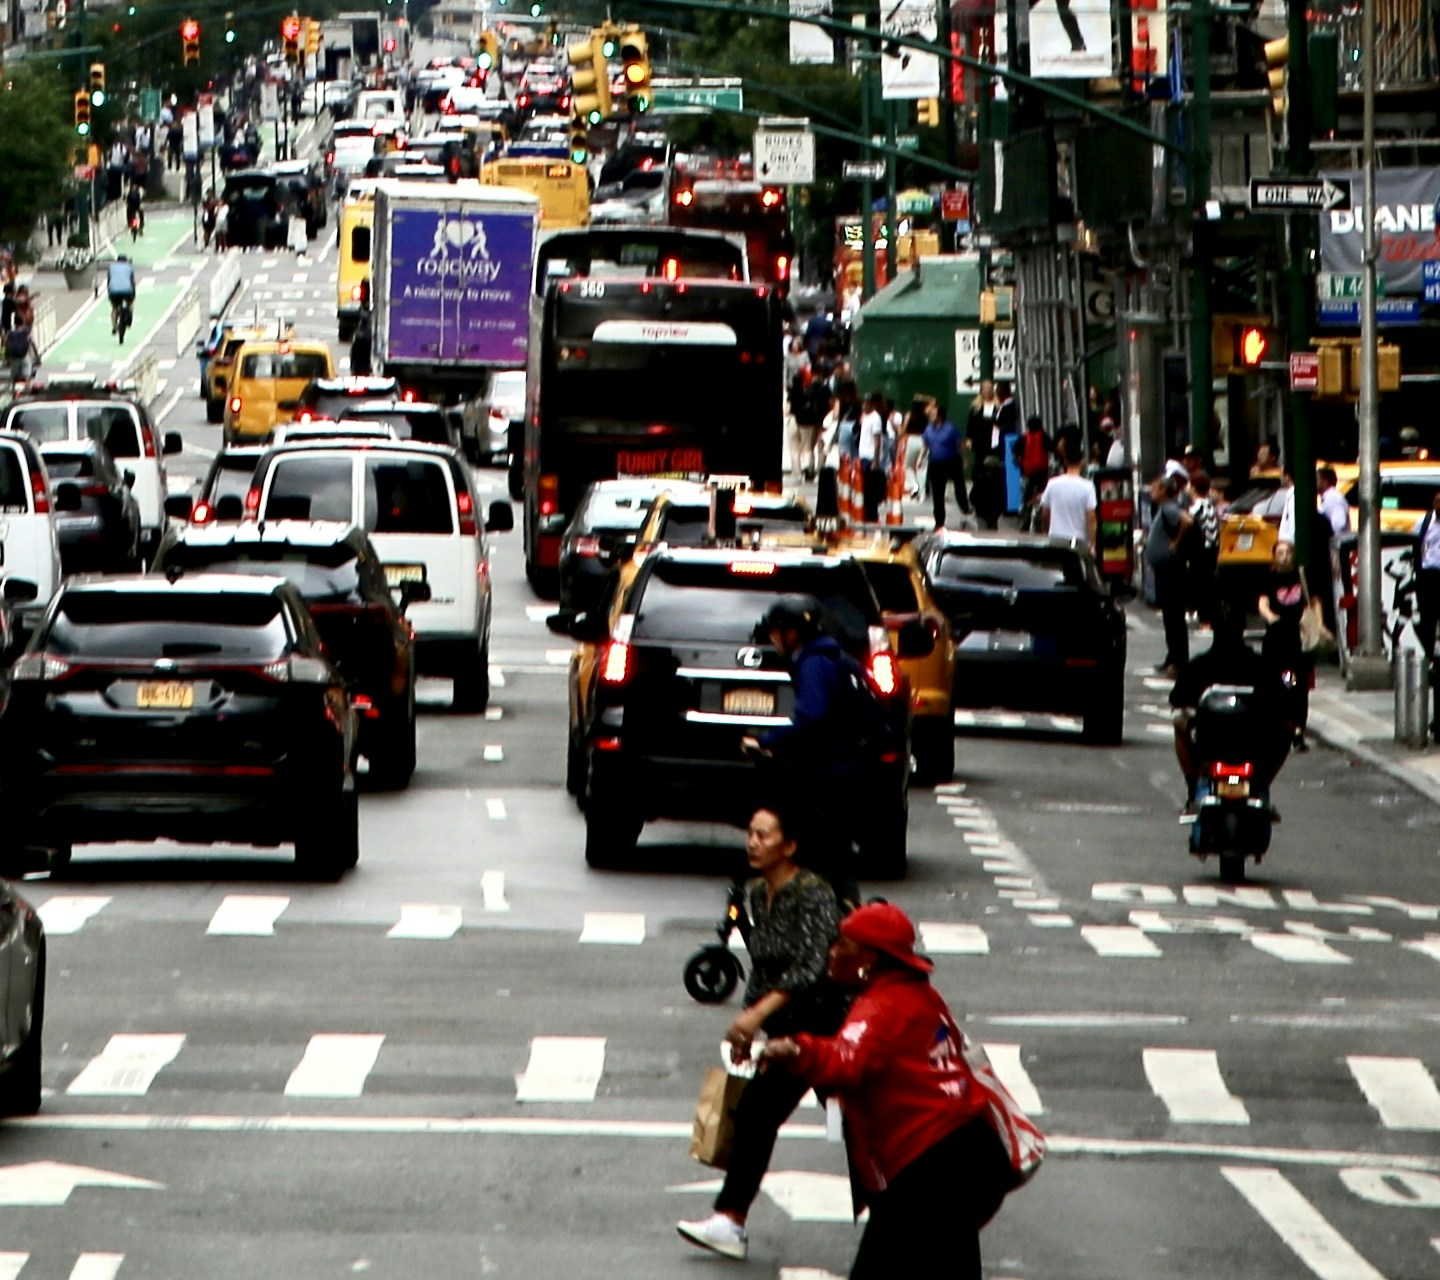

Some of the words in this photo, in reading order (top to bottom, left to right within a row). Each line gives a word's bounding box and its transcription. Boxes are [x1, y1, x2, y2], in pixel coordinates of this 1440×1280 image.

[765, 136, 803, 147] BUSES
[1265, 186, 1292, 201] ONE
[1307, 186, 1337, 202] WAY
[417, 256, 501, 281] roadway
[404, 286, 413, 297] A
[467, 288, 479, 300] to
[579, 281, 605, 298] 360
